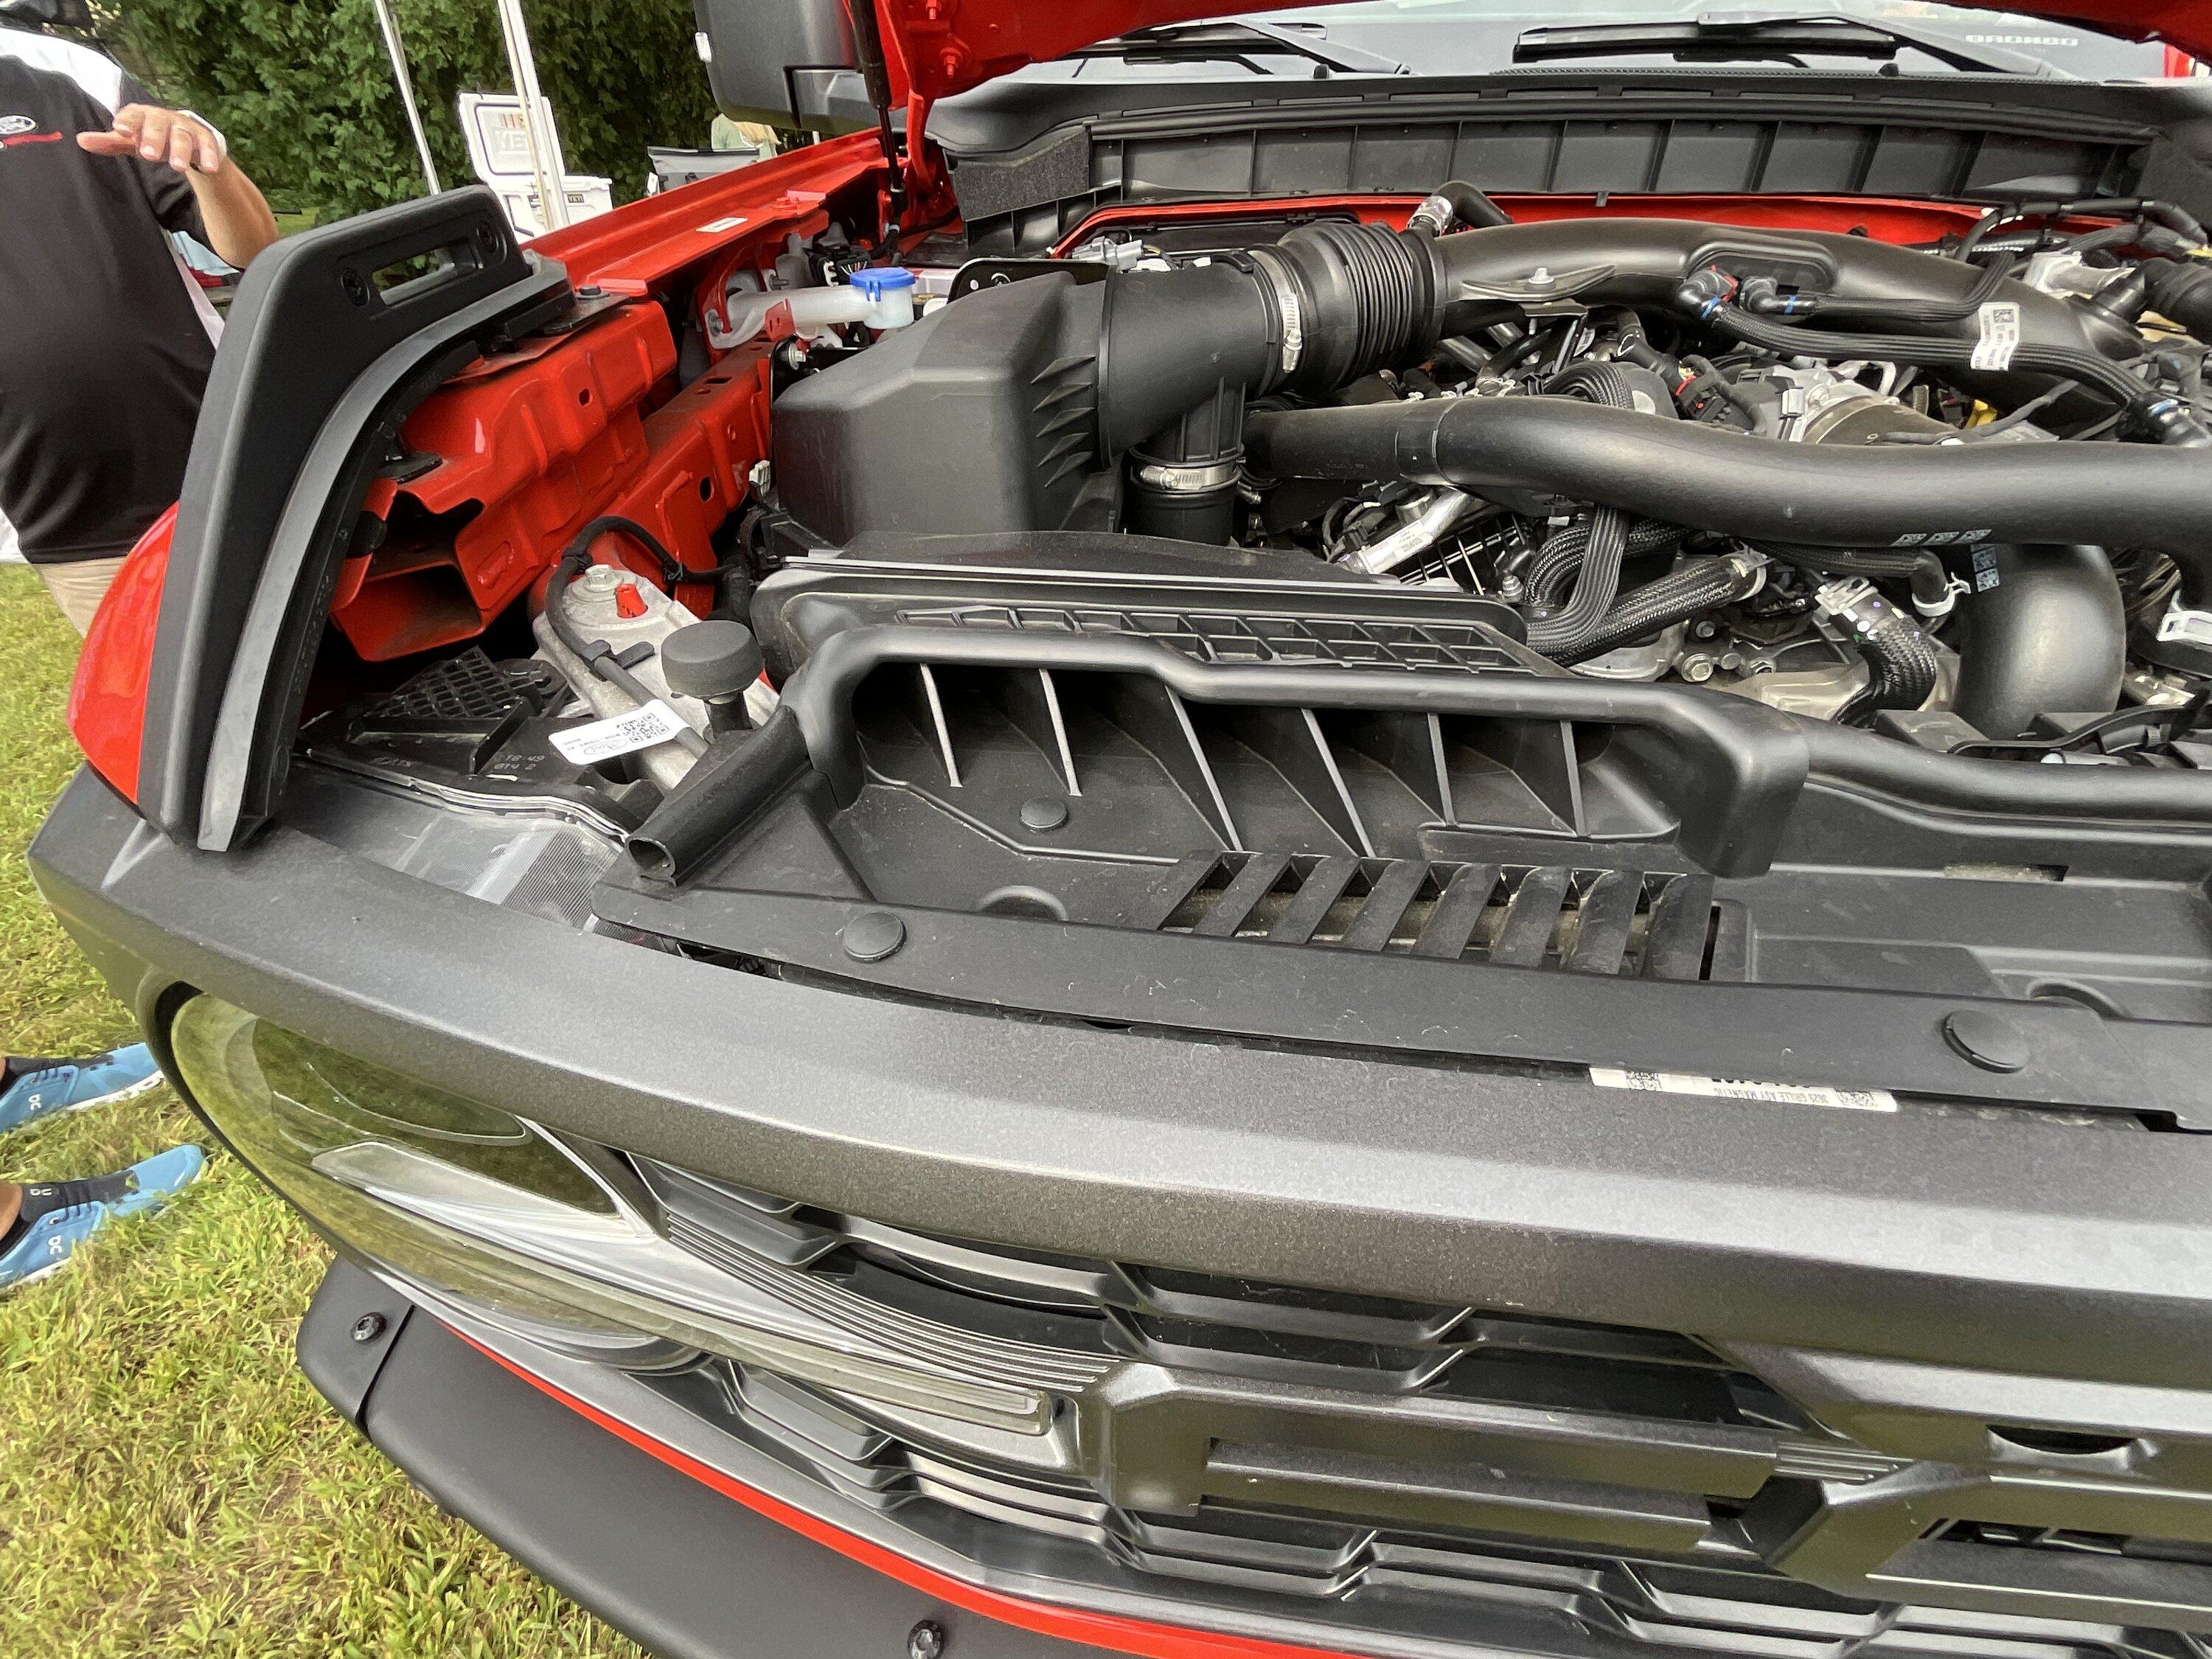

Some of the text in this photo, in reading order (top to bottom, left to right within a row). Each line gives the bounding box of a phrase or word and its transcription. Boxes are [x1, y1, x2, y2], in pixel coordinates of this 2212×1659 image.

[1714, 1088, 1759, 1099] MAGNETIC
[1761, 1091, 1776, 1102] ASY
[1779, 1091, 1807, 1102] GRILLE
